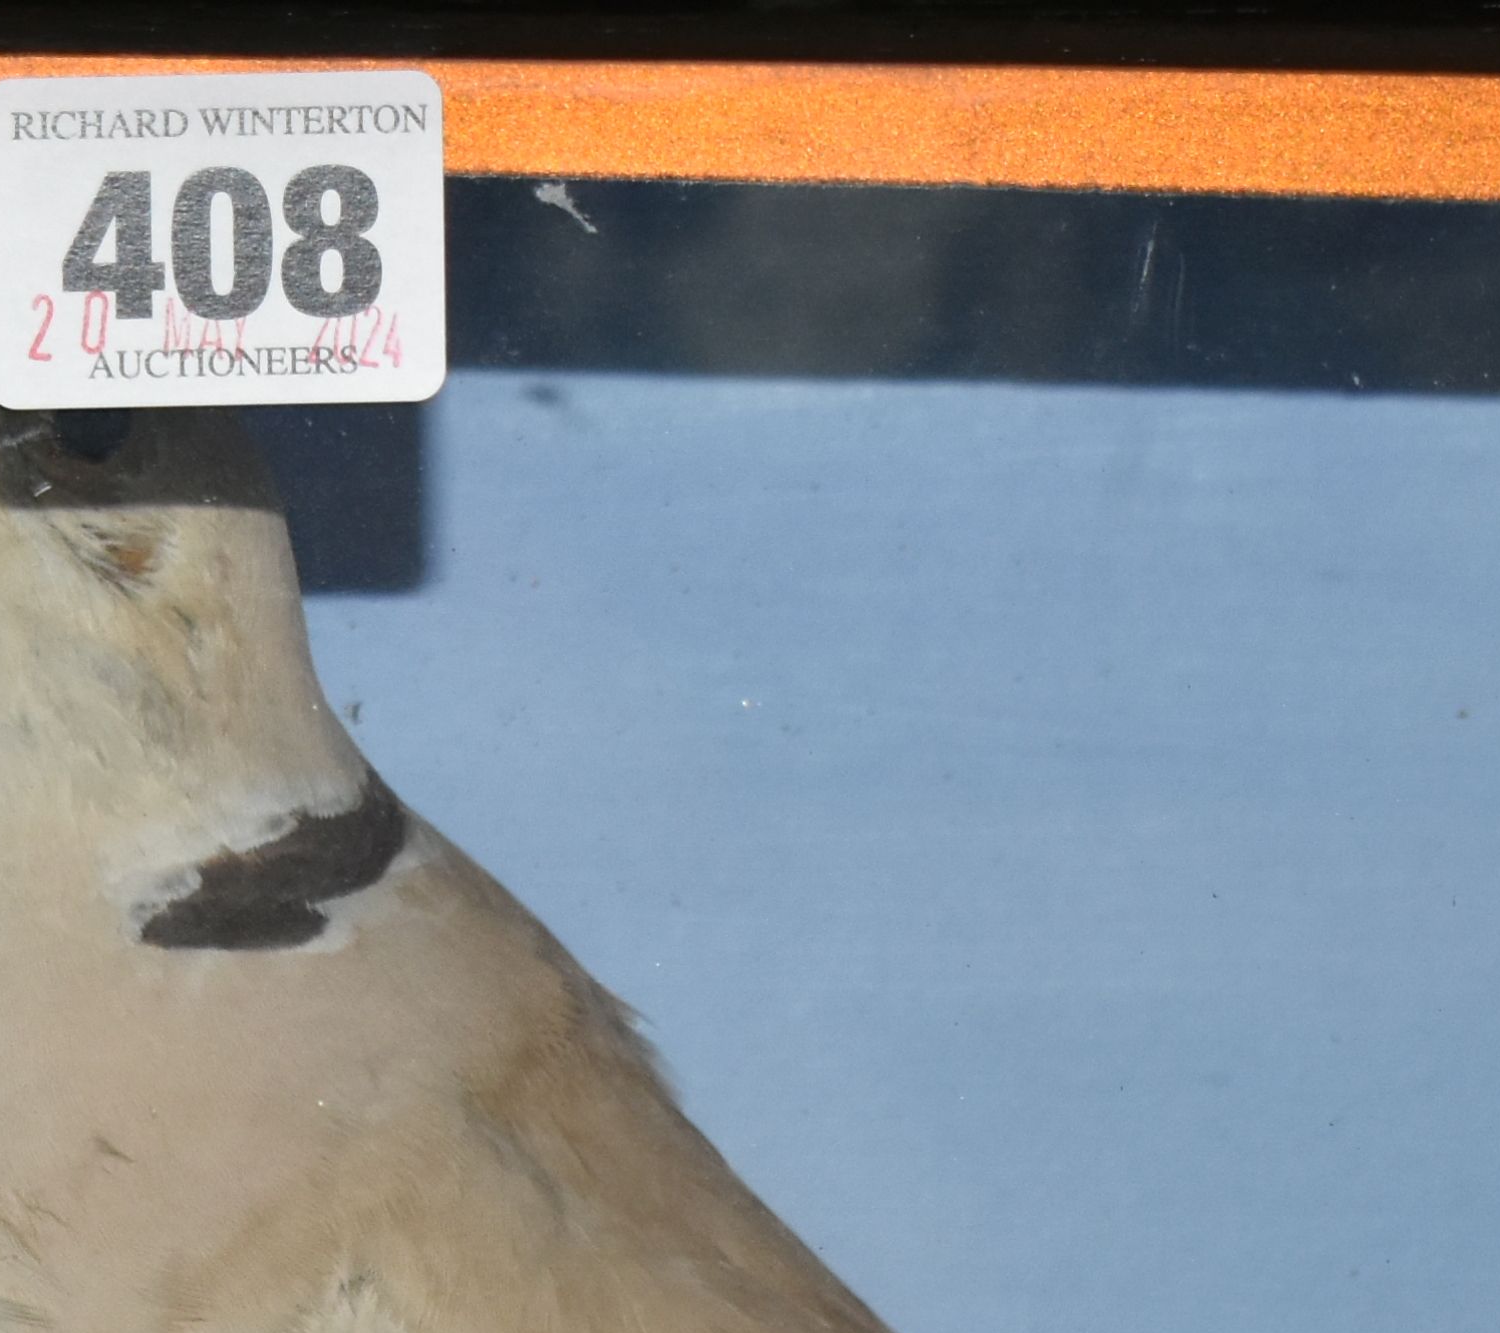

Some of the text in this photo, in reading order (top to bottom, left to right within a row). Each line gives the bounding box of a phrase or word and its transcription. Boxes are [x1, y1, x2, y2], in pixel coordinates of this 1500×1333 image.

[11, 103, 428, 140] RICHARD WINTERTON
[61, 164, 383, 320] 408
[89, 345, 358, 379] AUCTIONEERS
